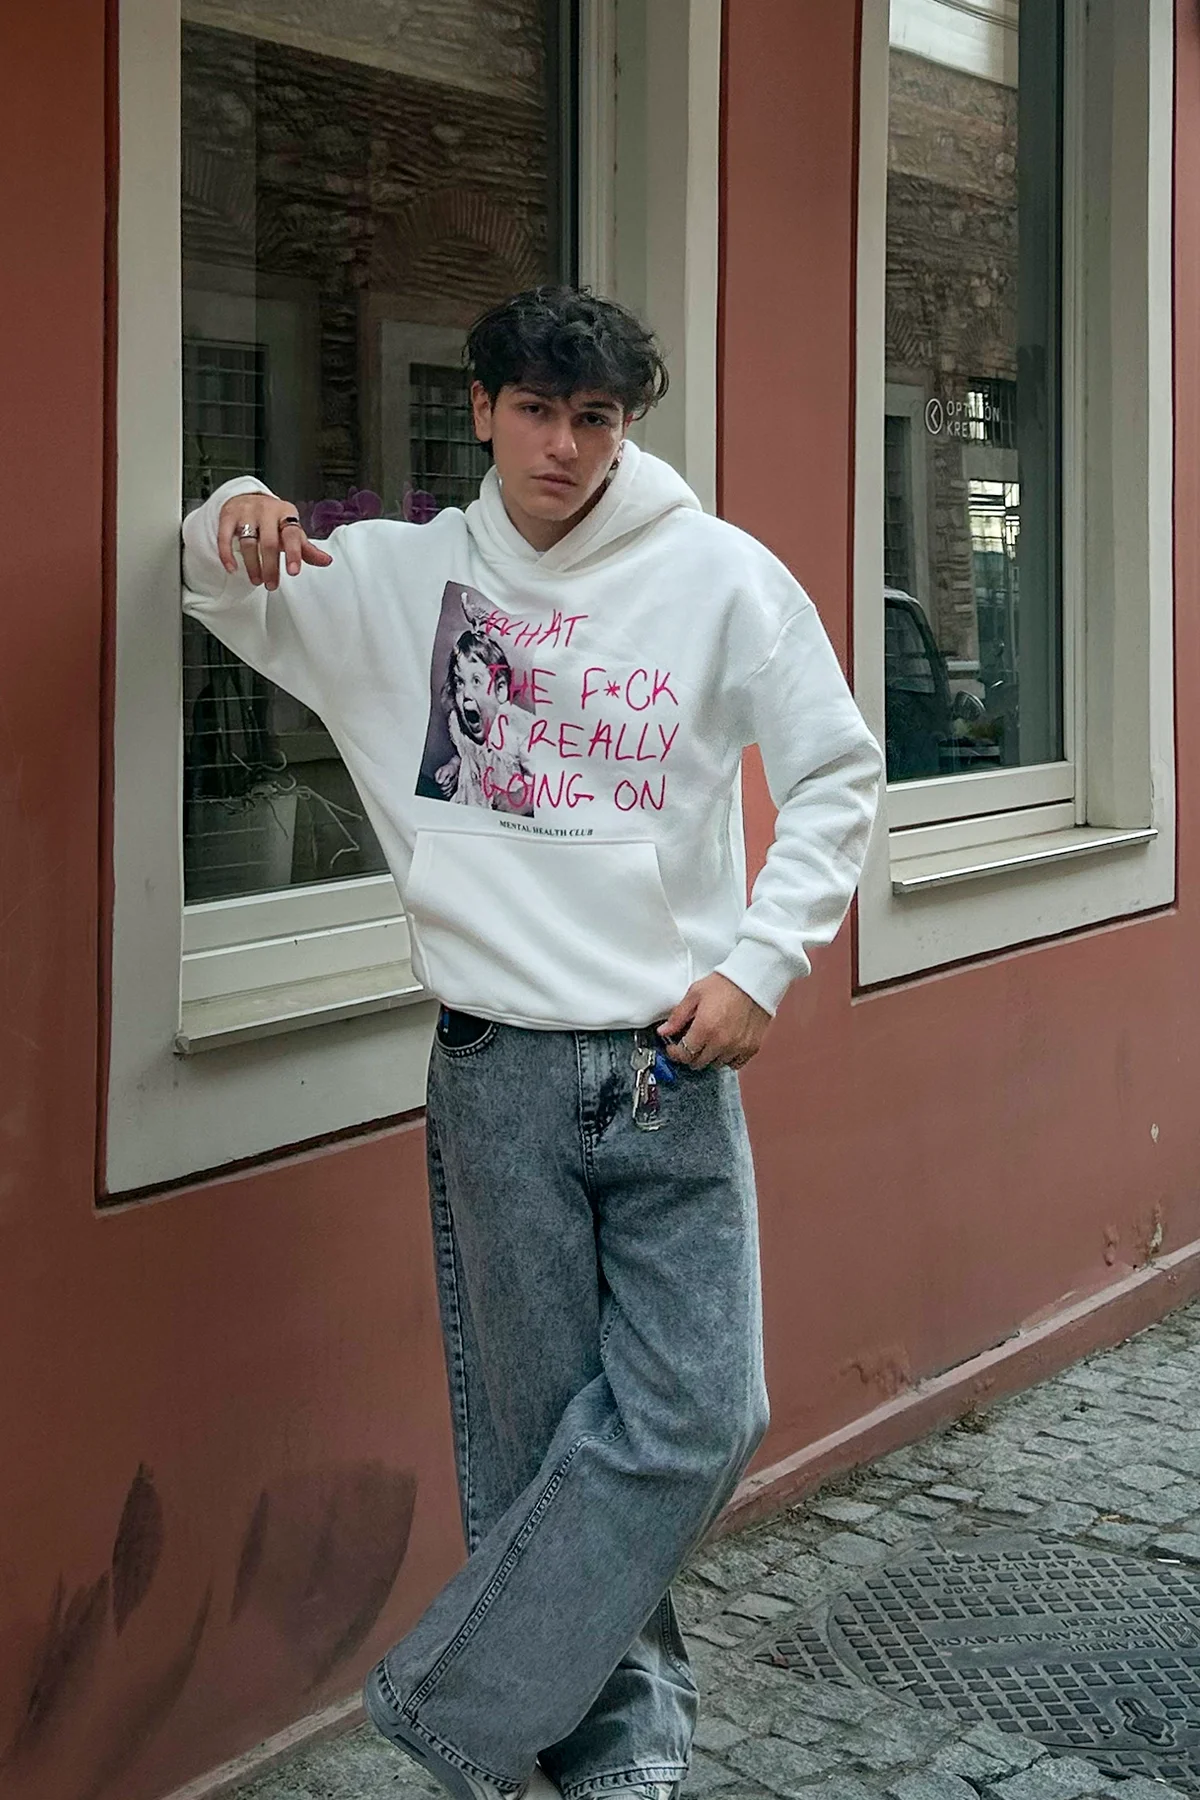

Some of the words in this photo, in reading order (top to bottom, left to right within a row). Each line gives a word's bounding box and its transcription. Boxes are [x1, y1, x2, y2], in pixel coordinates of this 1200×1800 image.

[485, 609, 588, 648] WHAT
[486, 663, 557, 705] THE
[484, 714, 509, 753] IS
[528, 719, 680, 762] REALLY
[482, 766, 595, 809] GOING
[614, 774, 666, 811] ON
[499, 820, 531, 833] MENTAL
[532, 826, 567, 837] HEALTH
[569, 828, 594, 837] CLUB
